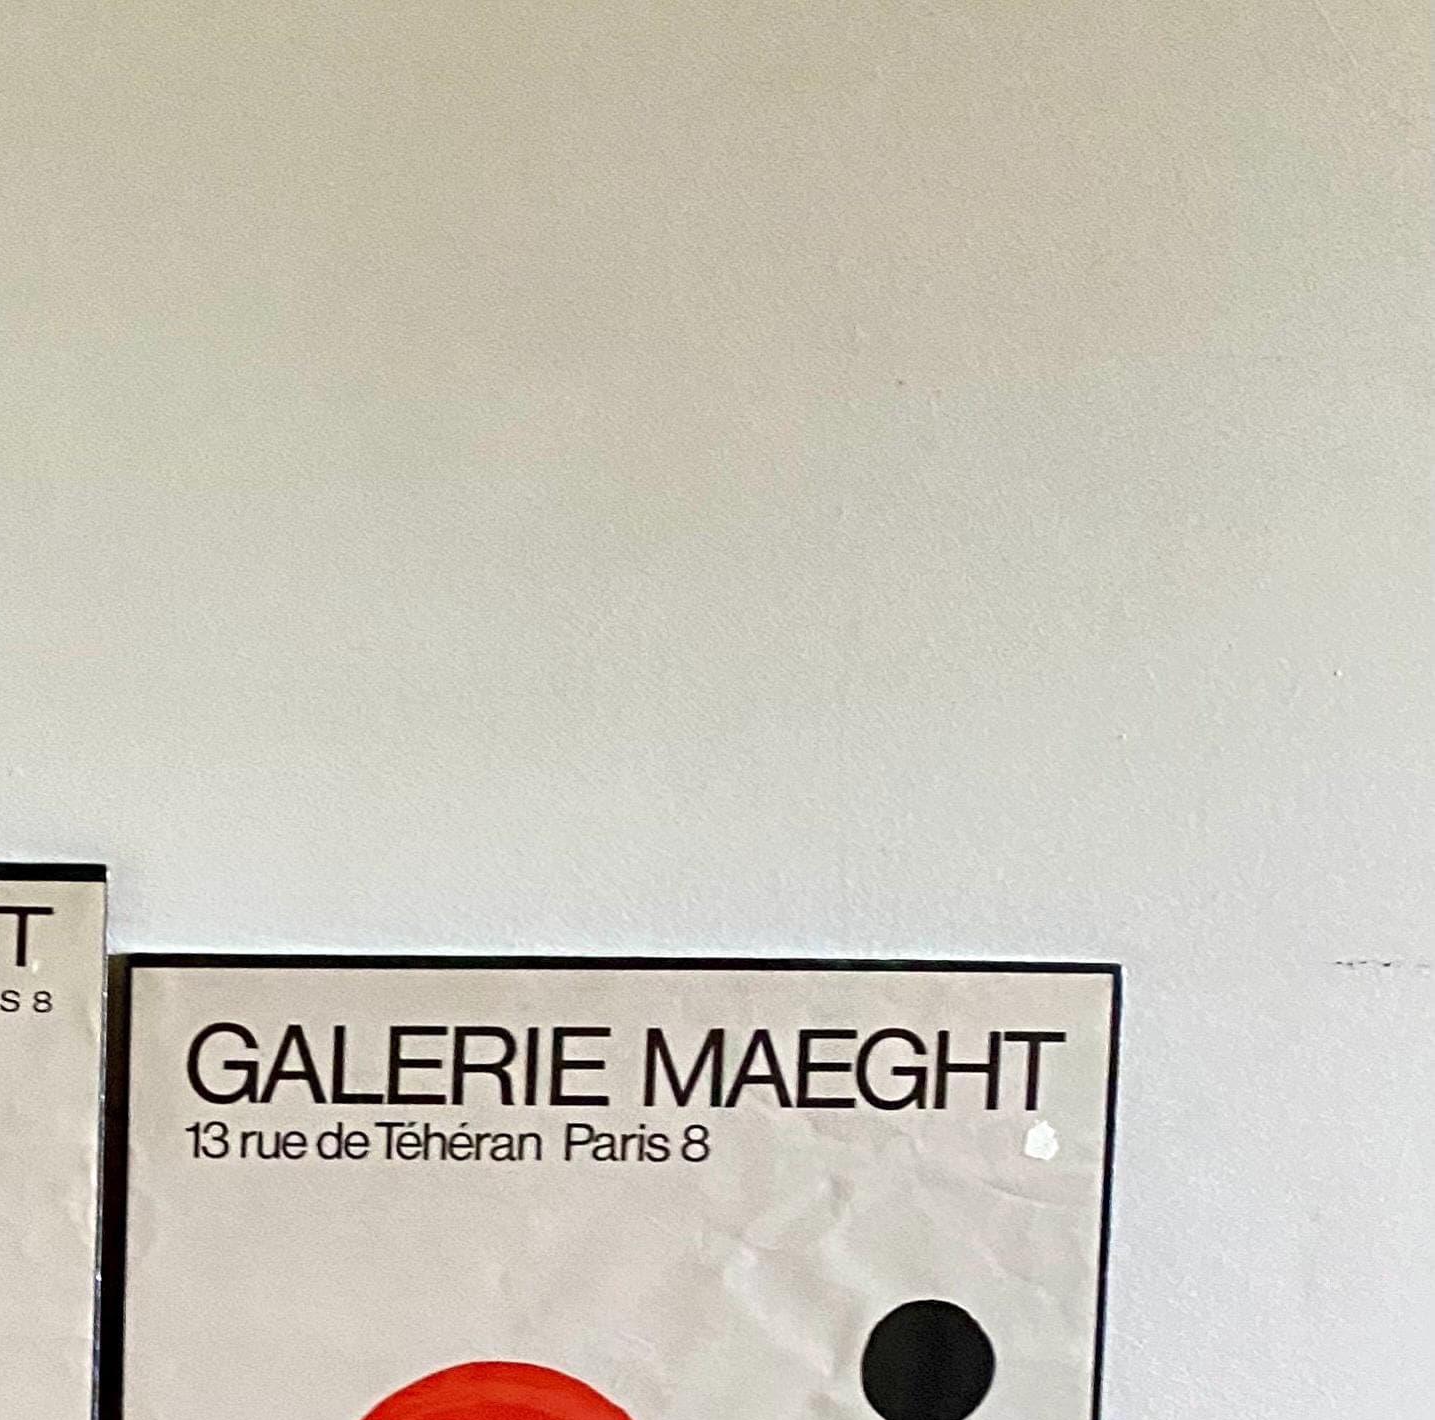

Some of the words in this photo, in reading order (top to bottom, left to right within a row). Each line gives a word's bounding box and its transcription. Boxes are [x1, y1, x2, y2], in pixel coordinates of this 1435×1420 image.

[33, 991, 53, 1013] 8
[186, 1022, 612, 1106] GALERIE
[643, 1027, 1067, 1111] MAEGHT
[185, 1121, 230, 1159] 13
[240, 1130, 308, 1160] rue
[316, 1122, 370, 1160] de
[375, 1121, 543, 1161] Téhéran
[564, 1124, 670, 1162] Paris
[681, 1124, 711, 1162] 8
